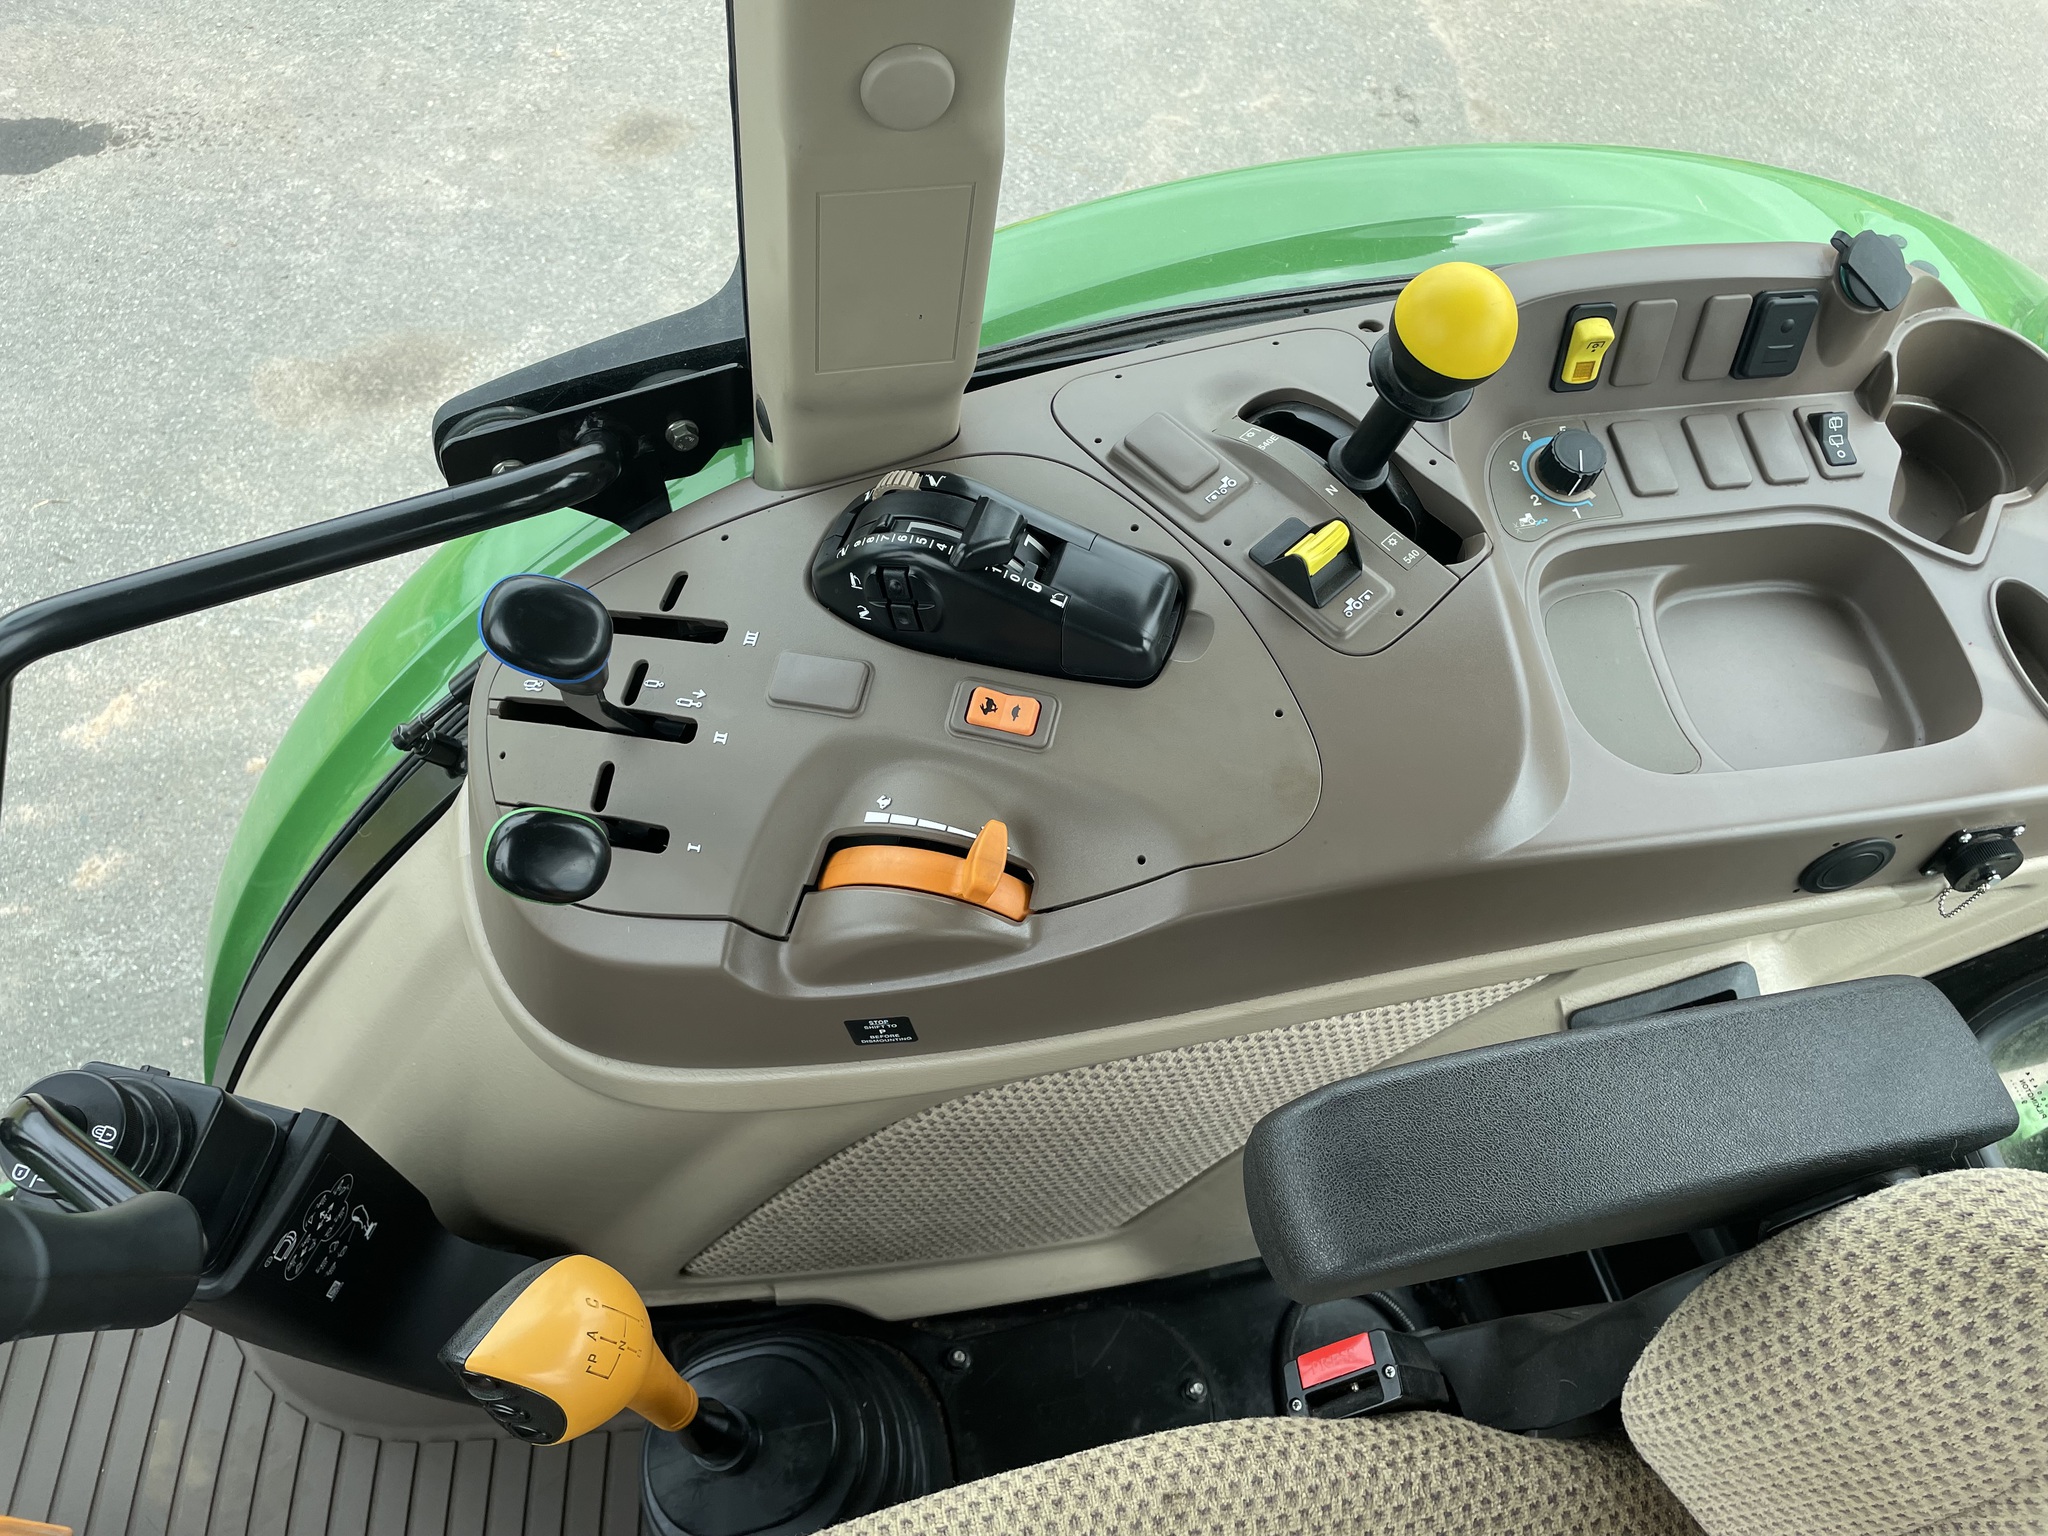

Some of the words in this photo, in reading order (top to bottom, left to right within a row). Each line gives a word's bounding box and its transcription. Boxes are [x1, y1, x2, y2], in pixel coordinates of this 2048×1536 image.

[1522, 430, 1532, 442] 4
[1257, 434, 1280, 451] 540E
[1509, 460, 1520, 472] 3
[1324, 484, 1339, 496] N
[1530, 494, 1542, 506] 2
[1572, 507, 1582, 519] 1
[915, 537, 928, 545] 5
[936, 542, 948, 552] 4
[1402, 549, 1420, 564] 540
[586, 1331, 599, 1342] A
[618, 1340, 626, 1351] N
[587, 1353, 597, 1363] P
